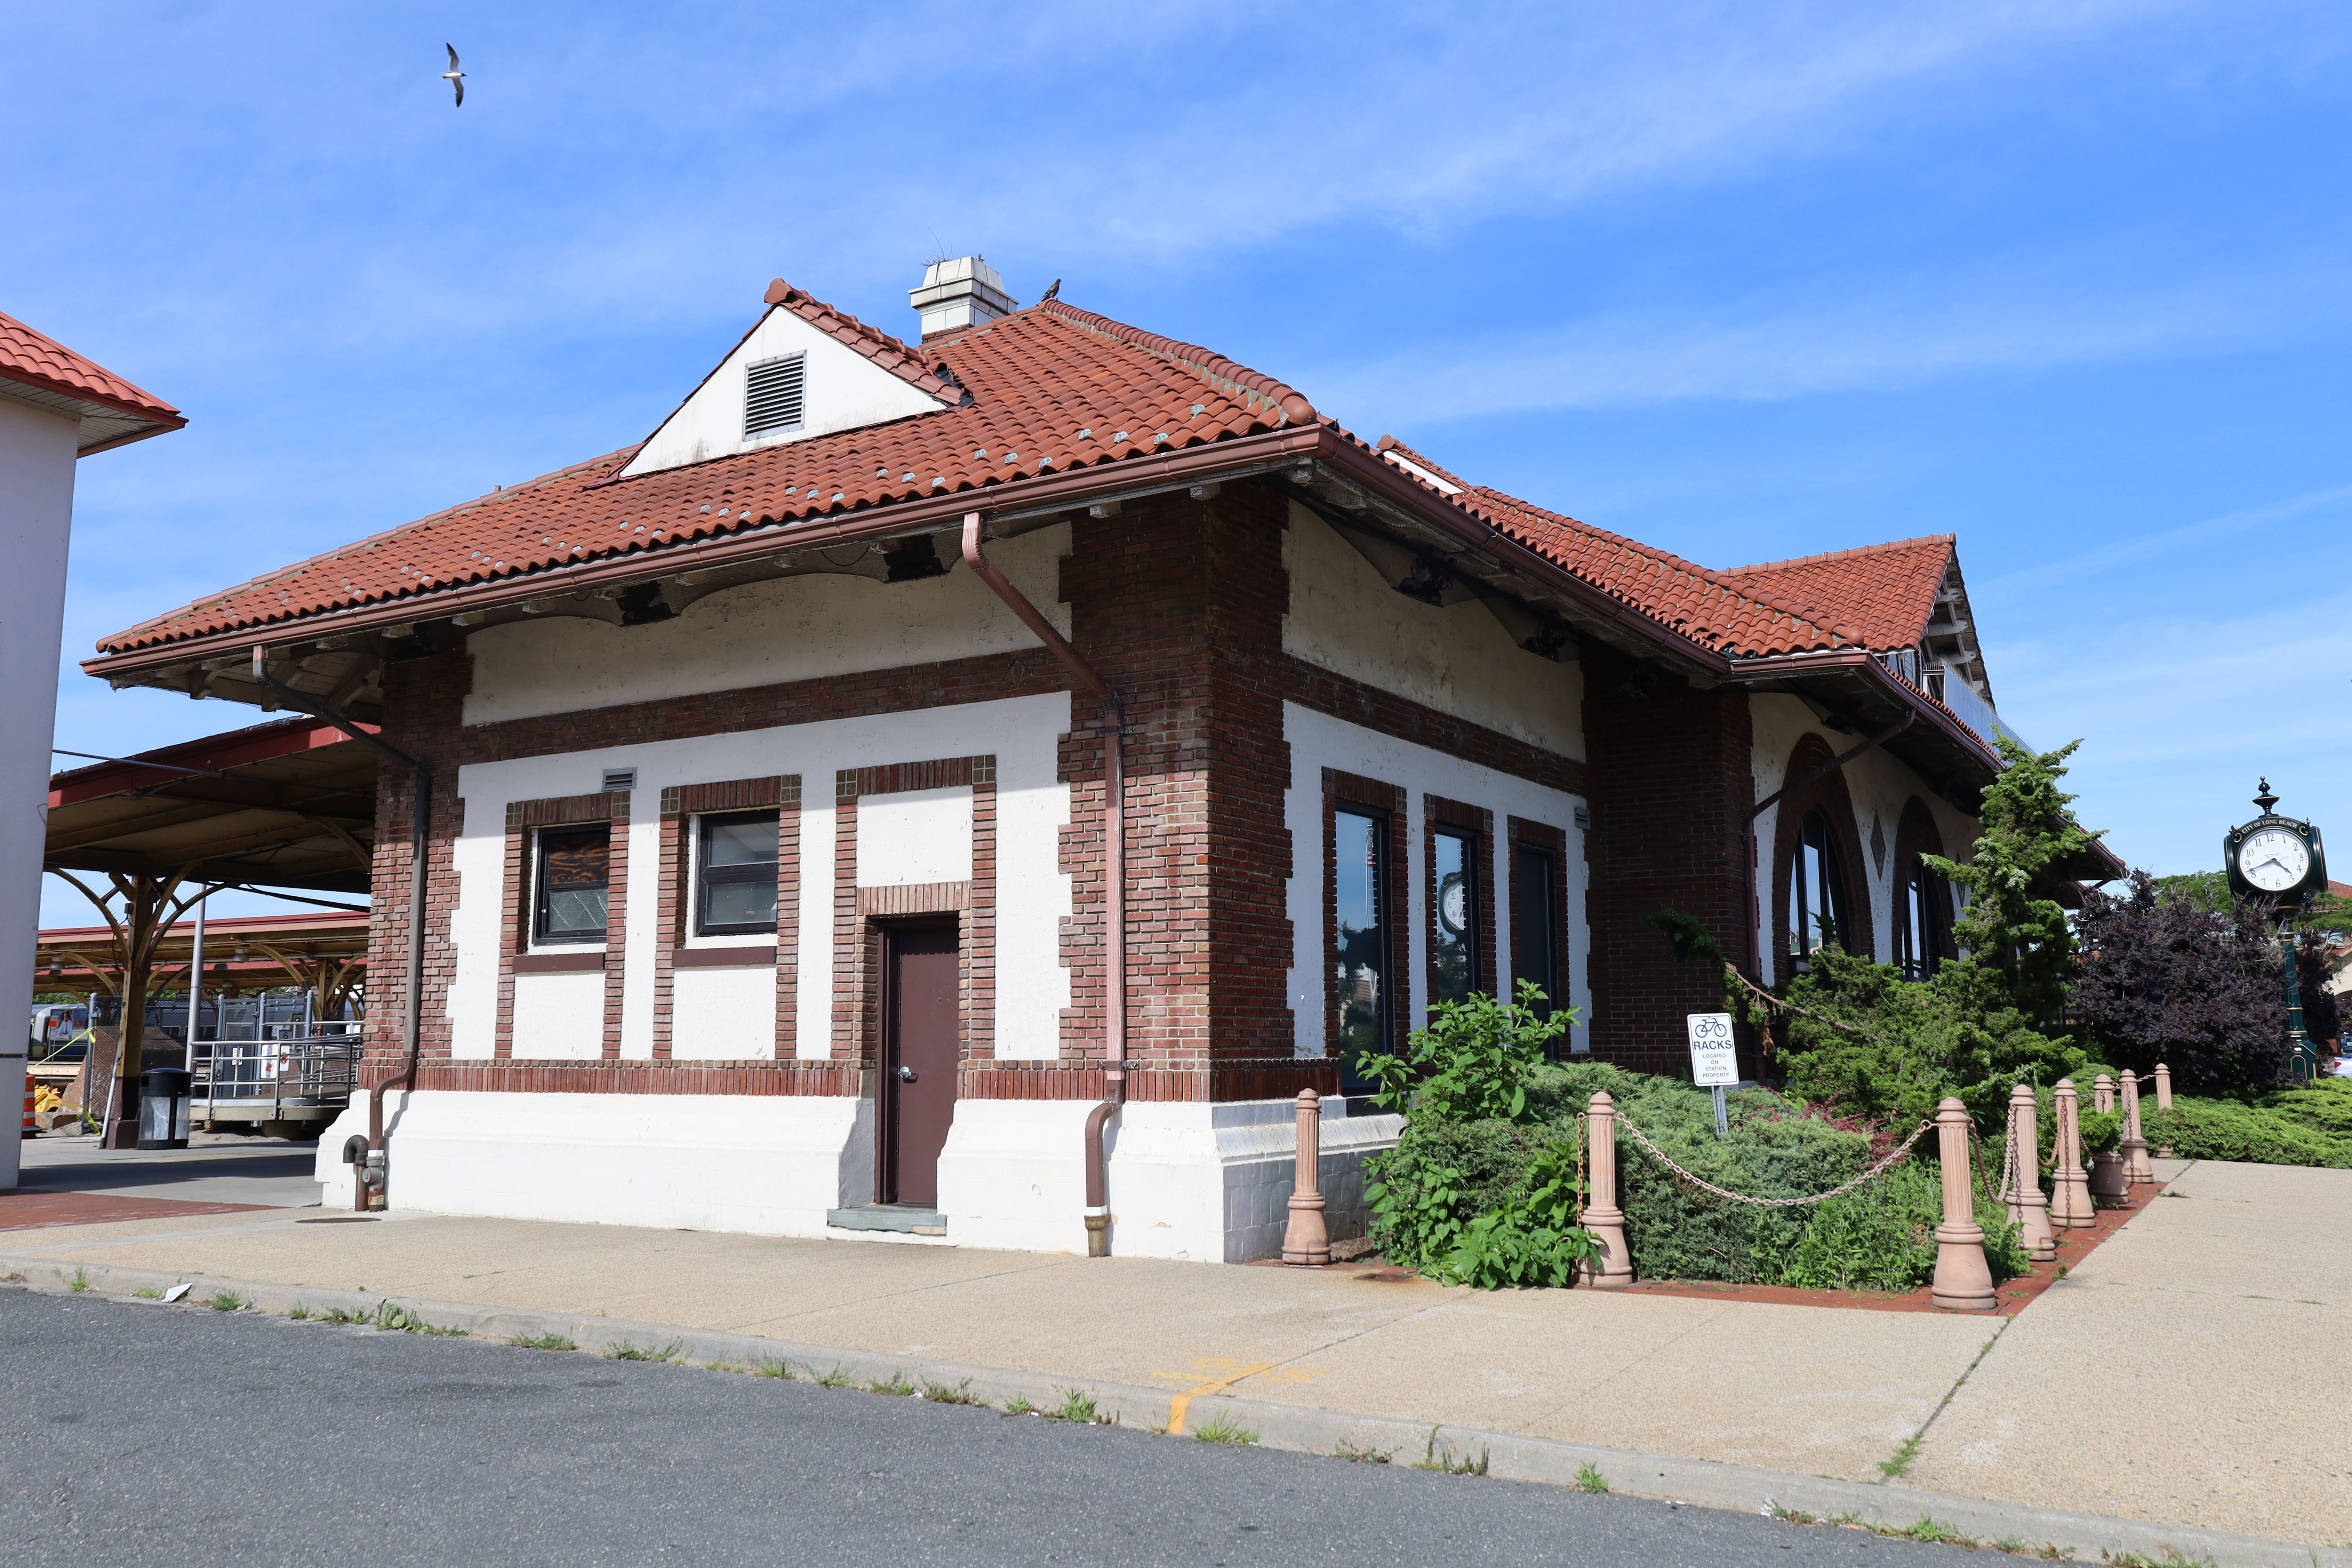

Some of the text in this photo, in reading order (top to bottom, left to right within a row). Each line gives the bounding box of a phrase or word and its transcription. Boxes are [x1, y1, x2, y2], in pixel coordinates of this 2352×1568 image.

[2242, 824, 2253, 833] CITY
[2279, 819, 2298, 828] BEACH
[2266, 833, 2275, 842] 12
[2255, 838, 2262, 847] 11
[2246, 848, 2254, 857] 10
[2299, 853, 2304, 862] 3
[2297, 864, 2302, 873] 4
[2251, 870, 2256, 878] 8
[2289, 874, 2295, 883] 5
[2260, 878, 2266, 887] 7
[1694, 1040, 1732, 1050] RACKS
